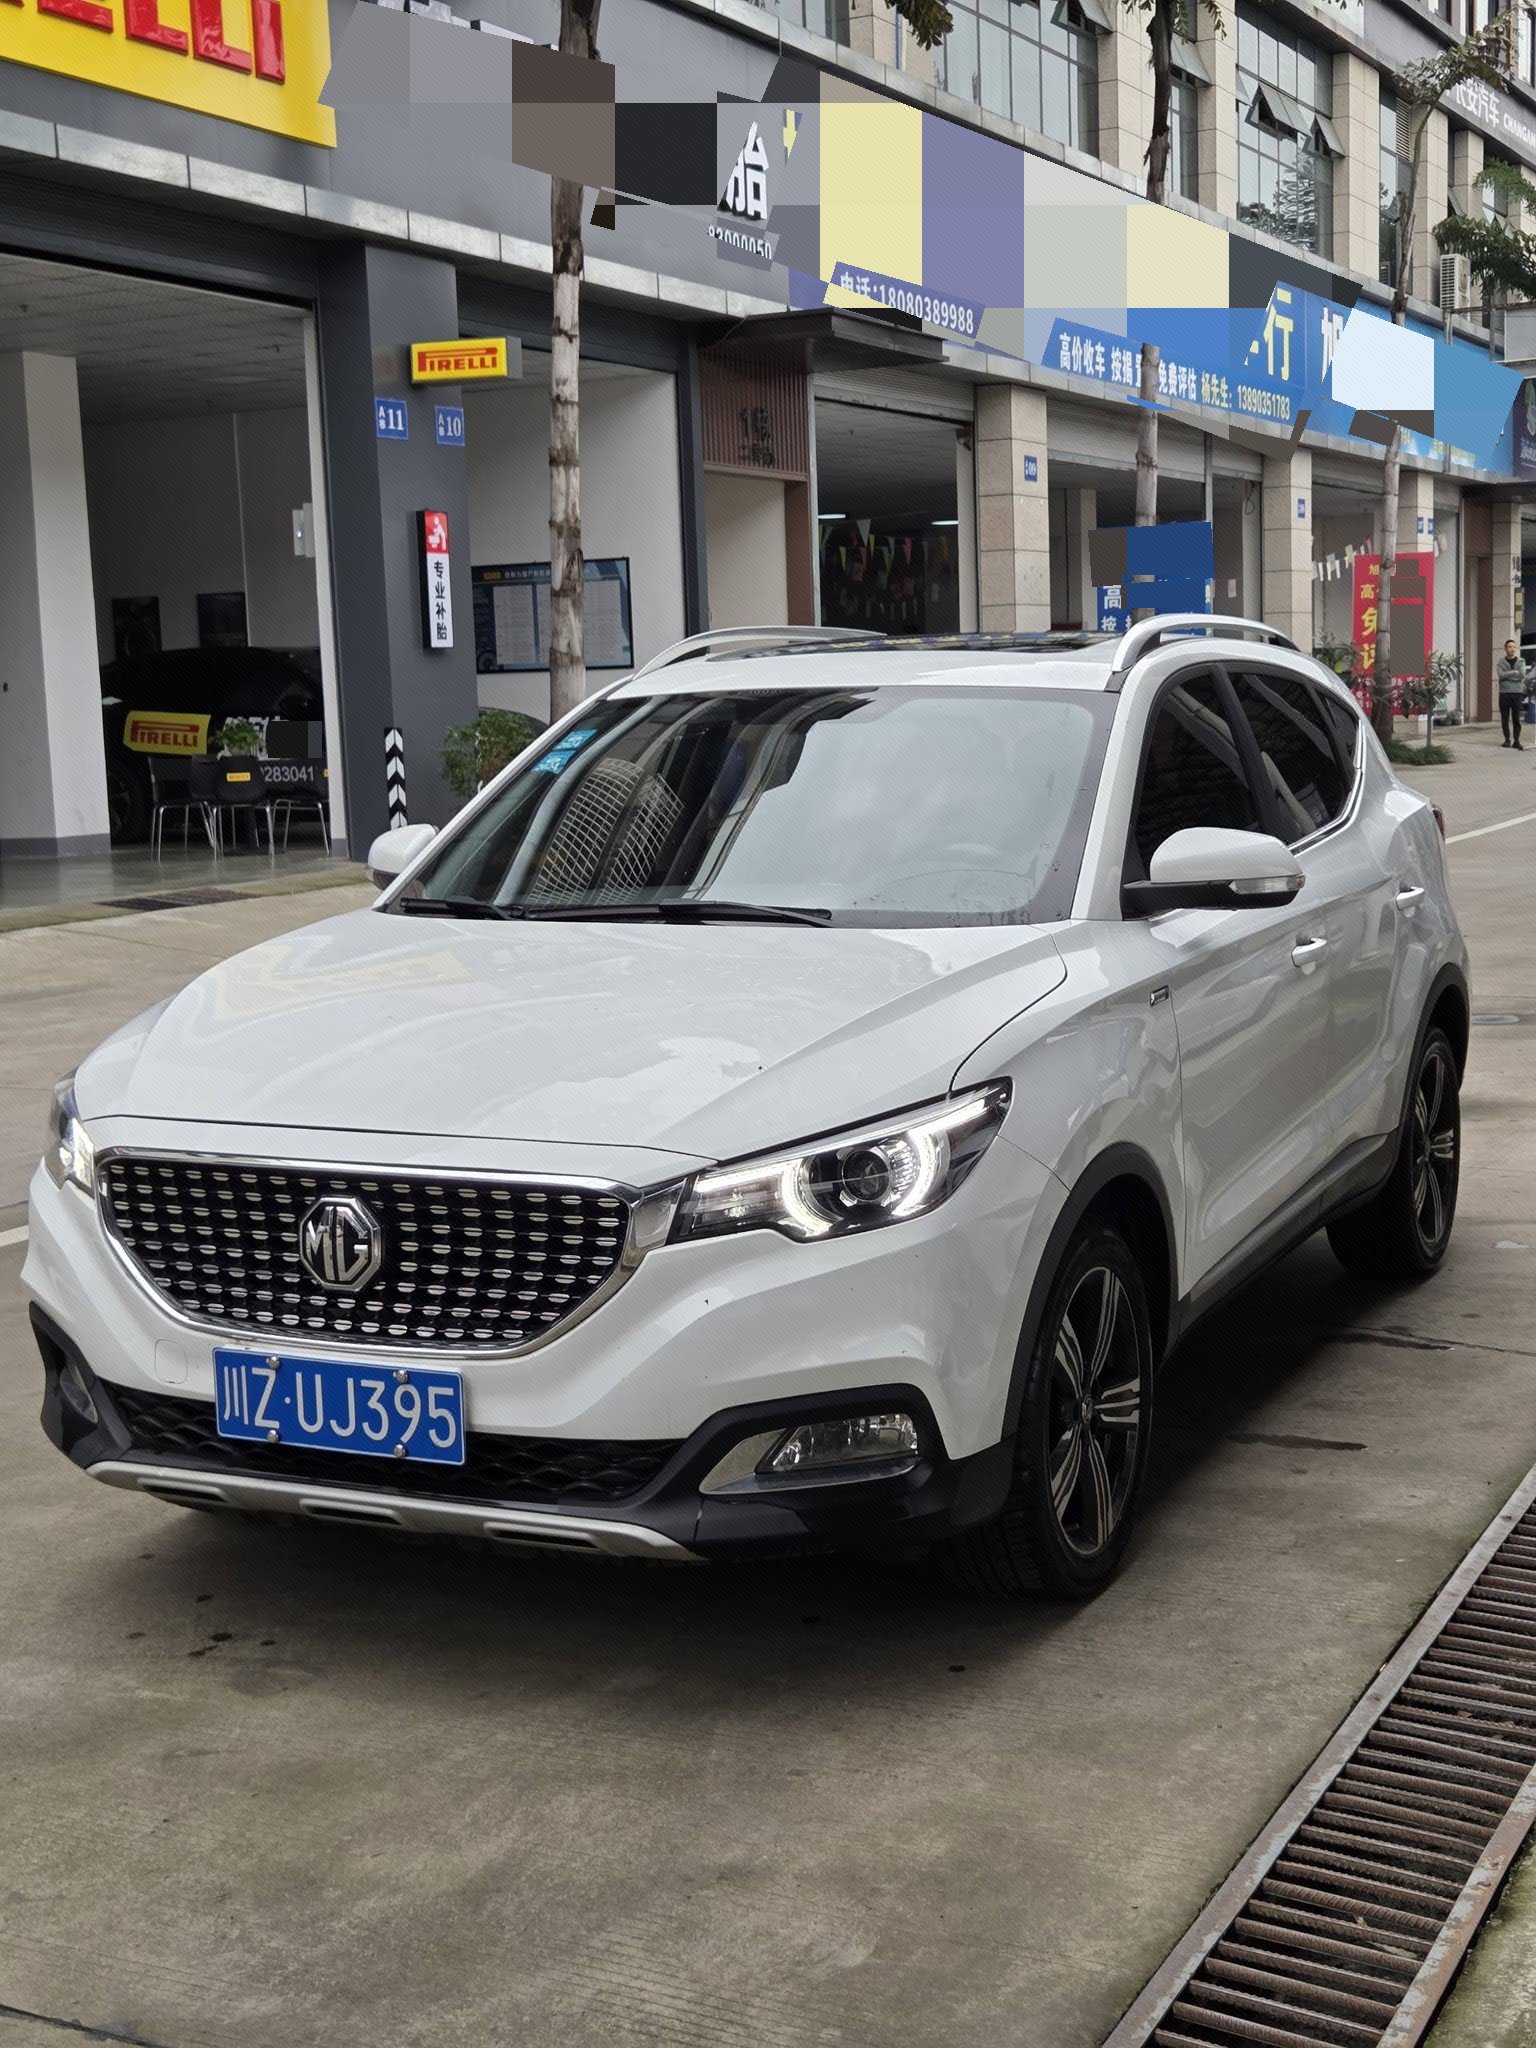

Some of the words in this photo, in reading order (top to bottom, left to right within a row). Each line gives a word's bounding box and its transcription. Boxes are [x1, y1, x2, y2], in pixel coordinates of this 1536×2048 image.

[418, 347, 498, 372] PIRELLI
[1059, 332, 1106, 379] 高价收车
[387, 408, 404, 431] 11
[446, 416, 461, 437] 10
[433, 560, 448, 641] 专业补胎
[130, 720, 200, 748] PIRELLI
[261, 766, 315, 782] 283041
[306, 1205, 369, 1281] MG
